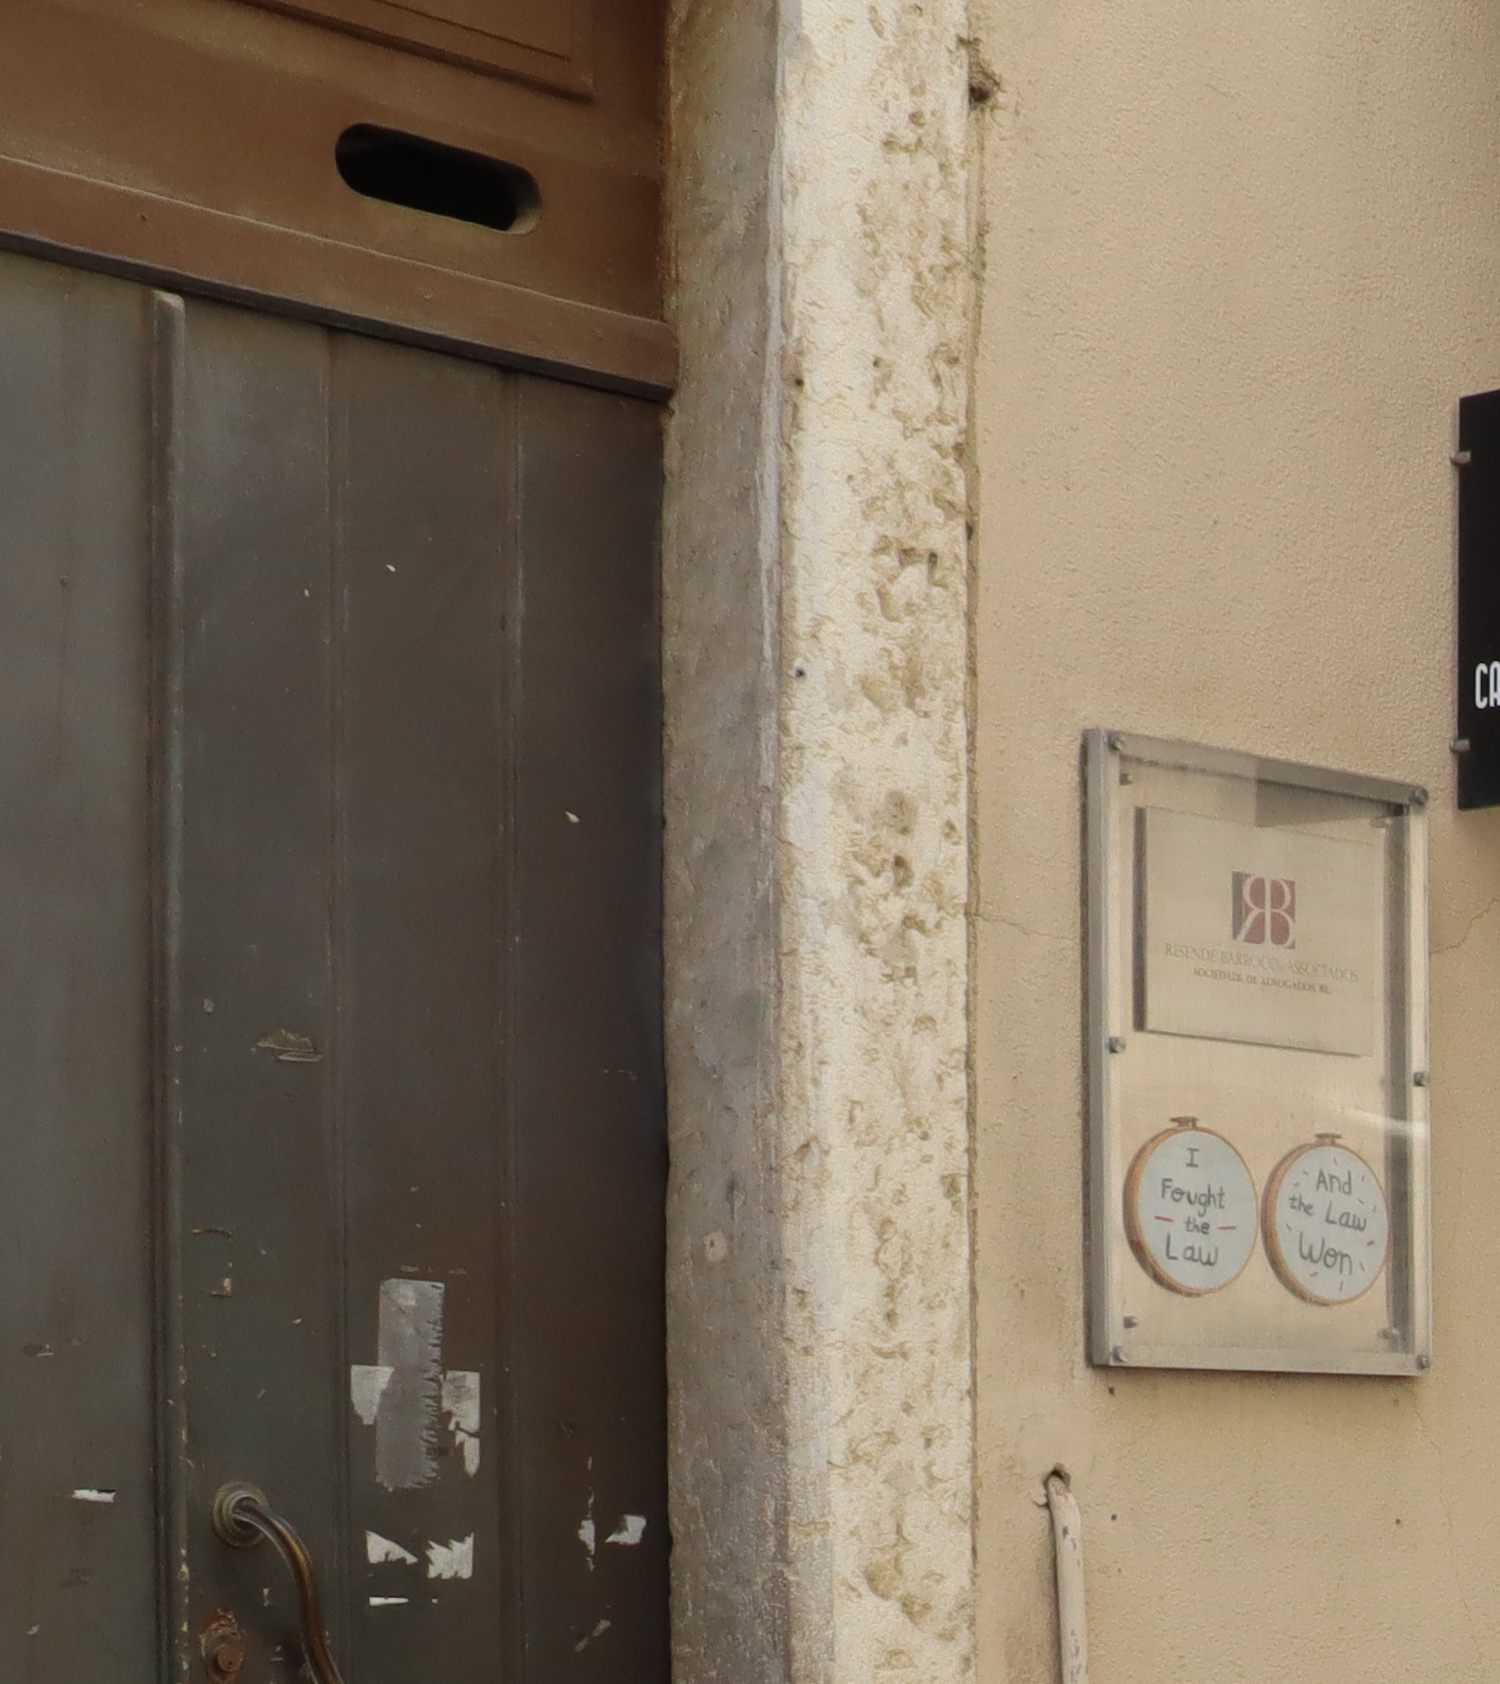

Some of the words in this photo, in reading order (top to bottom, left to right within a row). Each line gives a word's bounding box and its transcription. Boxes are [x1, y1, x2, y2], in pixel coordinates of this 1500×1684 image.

[1186, 1148, 1199, 1168] I
[1161, 1178, 1226, 1218] Fought
[1315, 1168, 1352, 1195] And
[1185, 1215, 1210, 1236] the
[1289, 1194, 1314, 1217] the
[1325, 1201, 1367, 1232] Law
[1165, 1233, 1218, 1267] Law
[1299, 1232, 1353, 1276] Won
